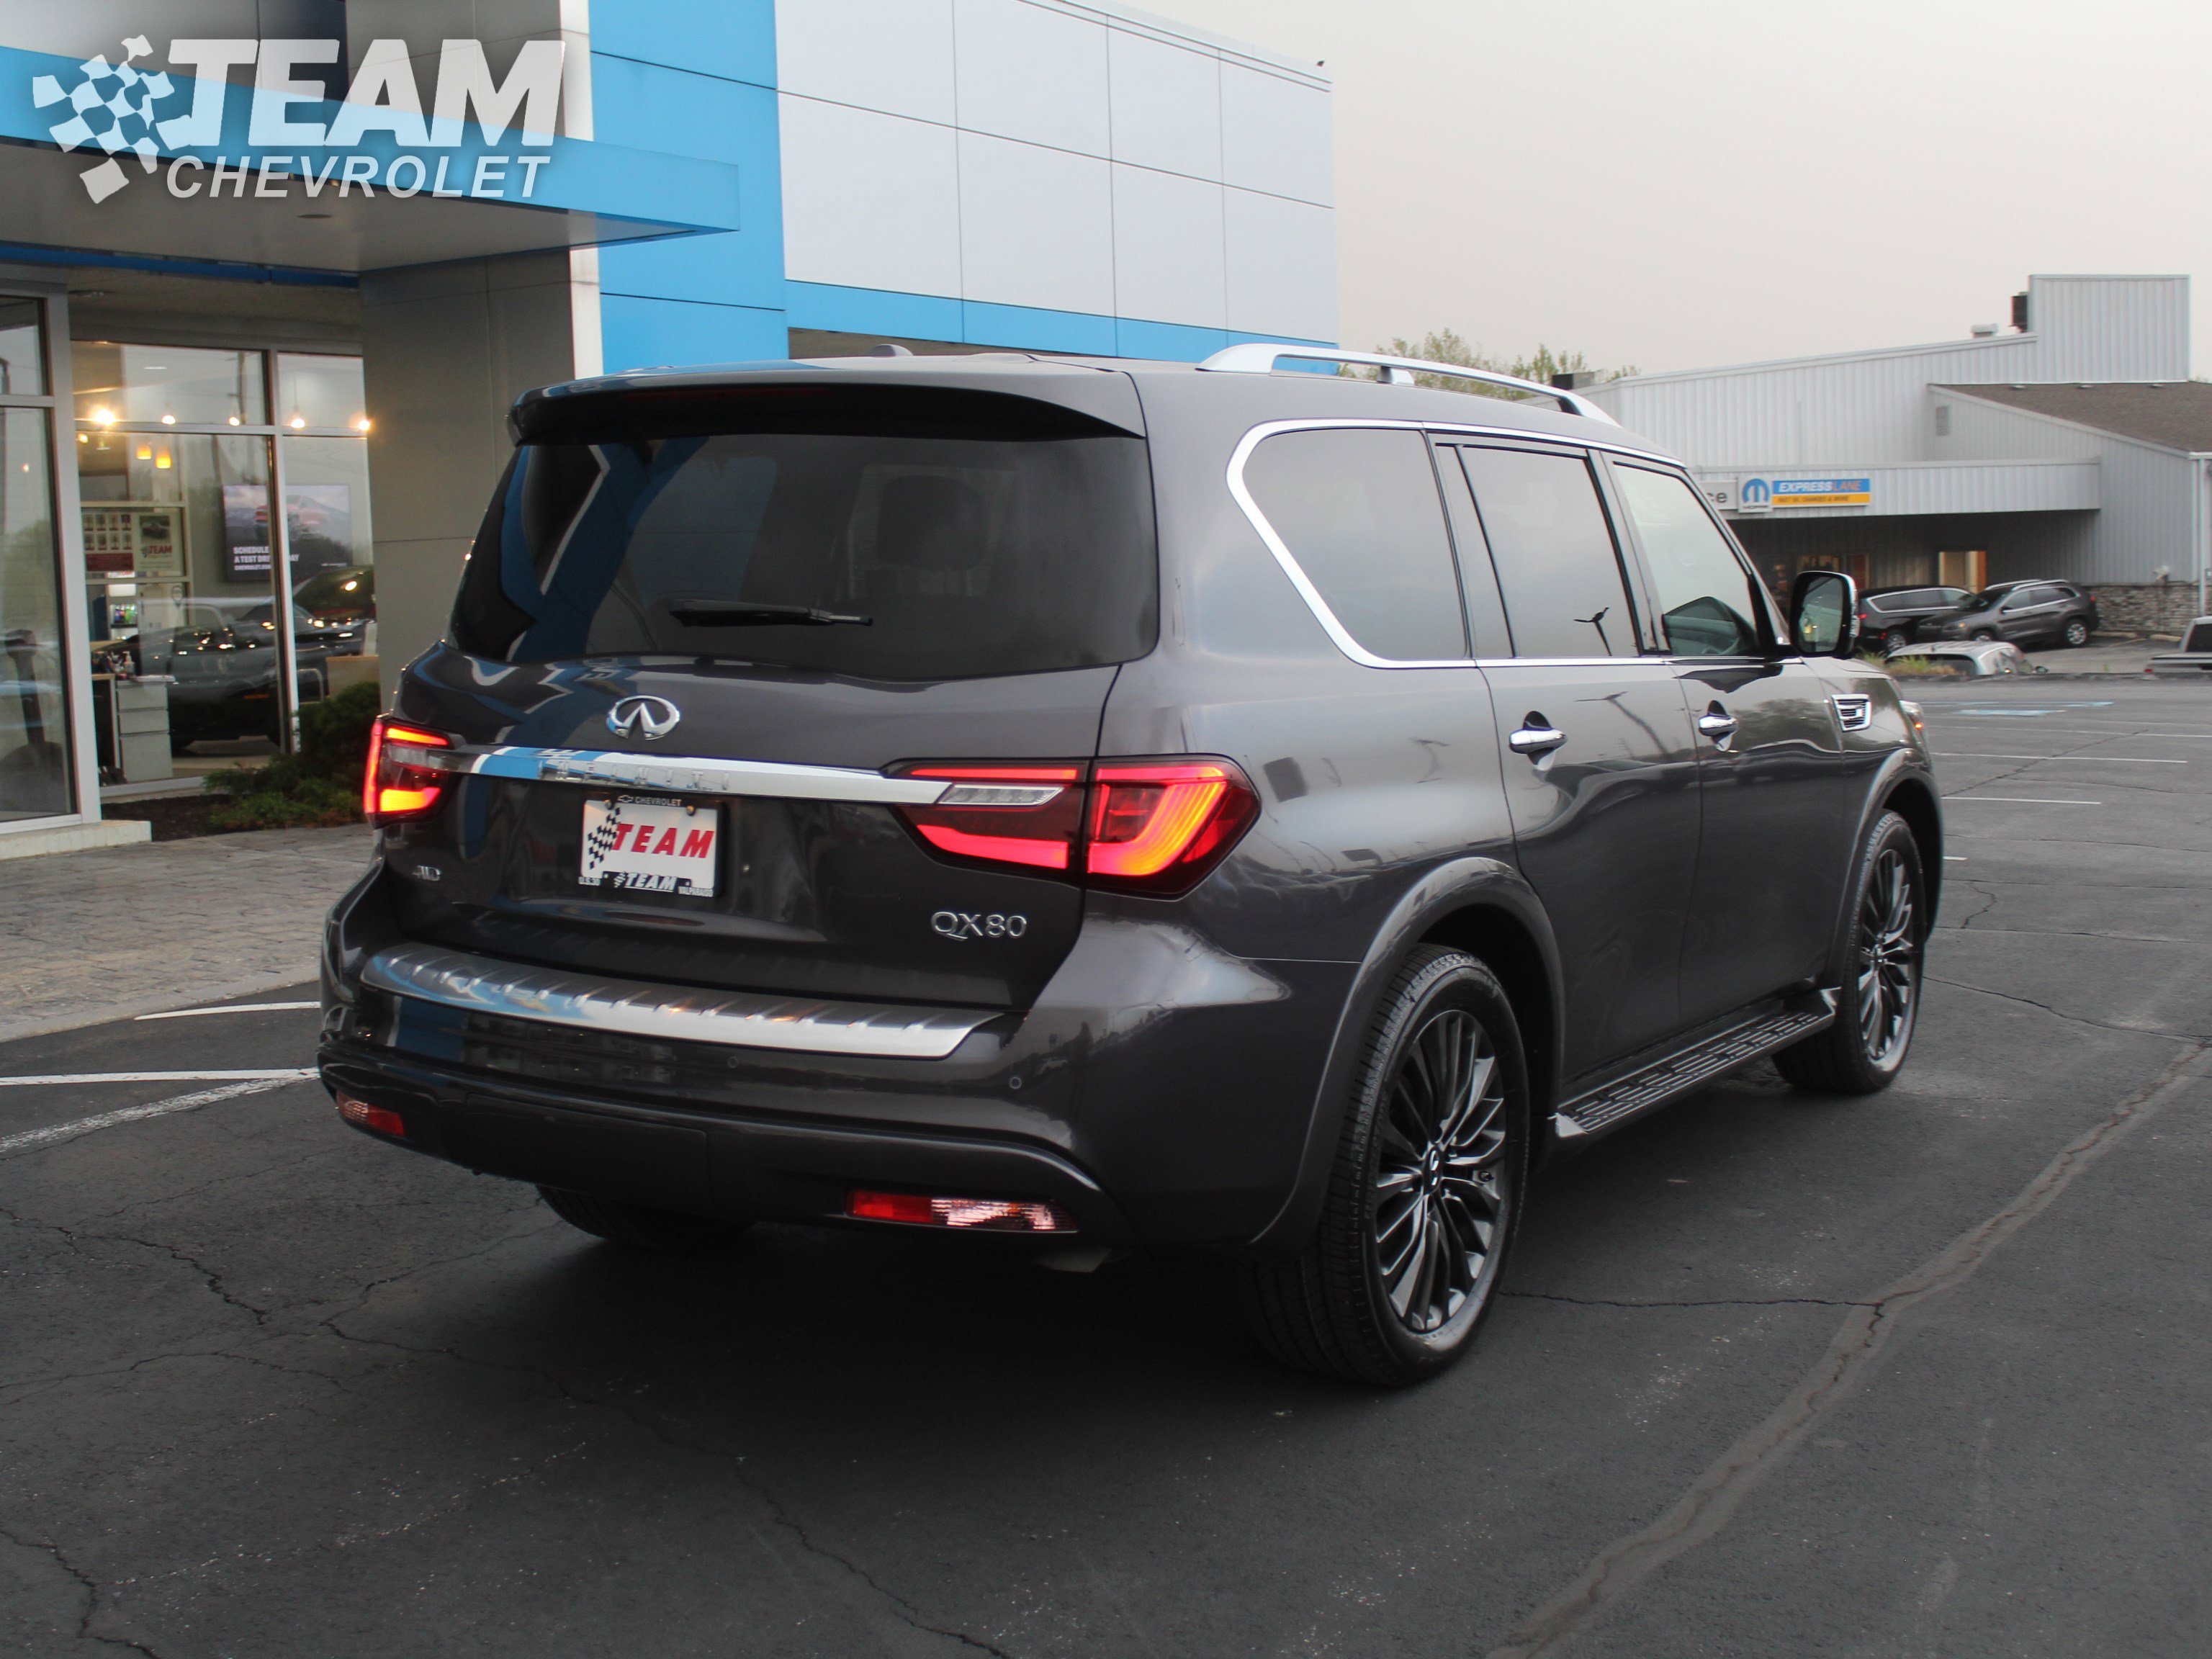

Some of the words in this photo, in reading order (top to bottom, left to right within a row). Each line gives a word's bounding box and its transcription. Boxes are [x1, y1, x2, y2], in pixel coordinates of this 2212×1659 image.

[634, 796, 682, 806] CHEVROLET
[611, 823, 714, 858] TEAM
[624, 872, 678, 891] TEAM
[931, 911, 1028, 941] QX80
